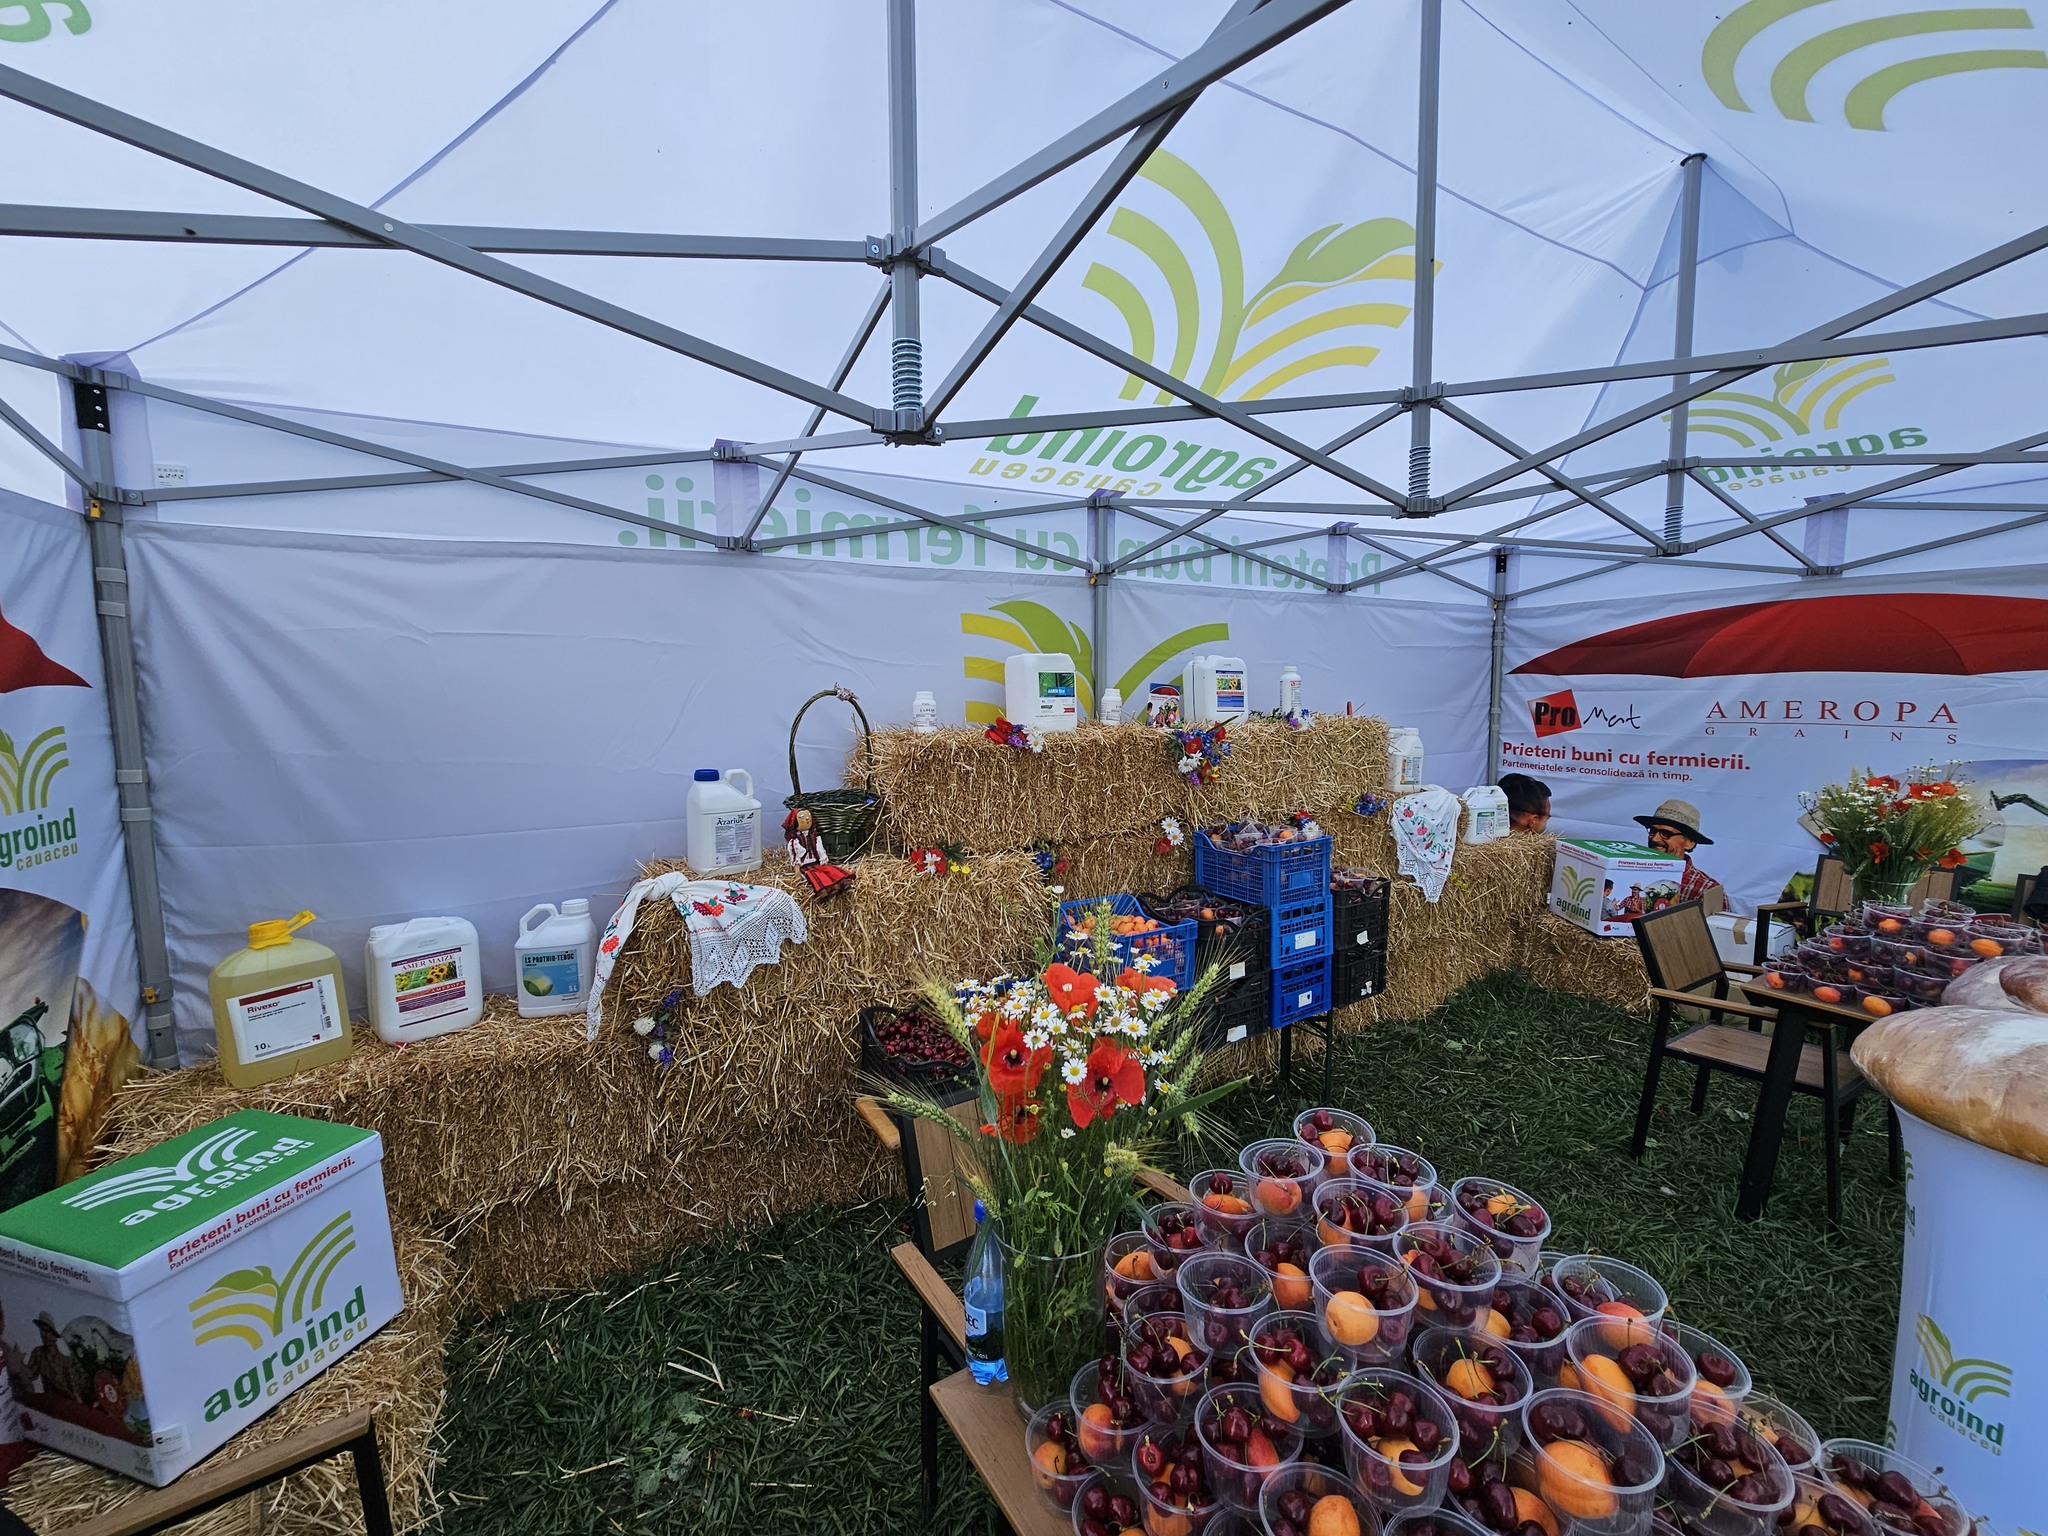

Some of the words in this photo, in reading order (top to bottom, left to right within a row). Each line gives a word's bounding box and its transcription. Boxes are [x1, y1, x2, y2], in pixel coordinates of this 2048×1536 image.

[1535, 701, 1576, 728] Pro
[1705, 700, 1959, 724] AMEROPA
[1705, 726, 1957, 745] GRAINS
[1502, 741, 1566, 761] Prieteni
[1571, 746, 1613, 763] buni
[1618, 752, 1641, 766] cu
[1647, 750, 1751, 770] fermierii.
[1502, 758, 1563, 773] Parteneriatele
[1565, 765, 1577, 773] se
[1579, 764, 1645, 778] consolidează
[1648, 769, 1659, 780] în
[1662, 770, 1693, 783] timp.
[716, 817, 743, 826] Azarius
[16, 842, 78, 871] cauaceu
[1556, 895, 1592, 921] agroind
[401, 960, 427, 971] AMER
[428, 953, 456, 965] MAIZE
[254, 1042, 267, 1051] 10
[119, 1137, 308, 1226] agroind
[200, 1141, 315, 1198] cauaceu
[167, 1218, 233, 1263] Prieteni
[236, 1198, 271, 1224] buni
[274, 1190, 292, 1204] cu
[294, 1156, 356, 1193] fermierii.
[169, 1233, 232, 1271] Parteneriatele
[233, 1227, 243, 1235] se
[244, 1198, 295, 1229] consolidează
[305, 1183, 324, 1198] timp.
[203, 1285, 367, 1423] agroind
[266, 1317, 368, 1398] cauaceu
[1909, 1368, 2005, 1446] agroind
[1929, 1404, 2002, 1457] cauaceu
